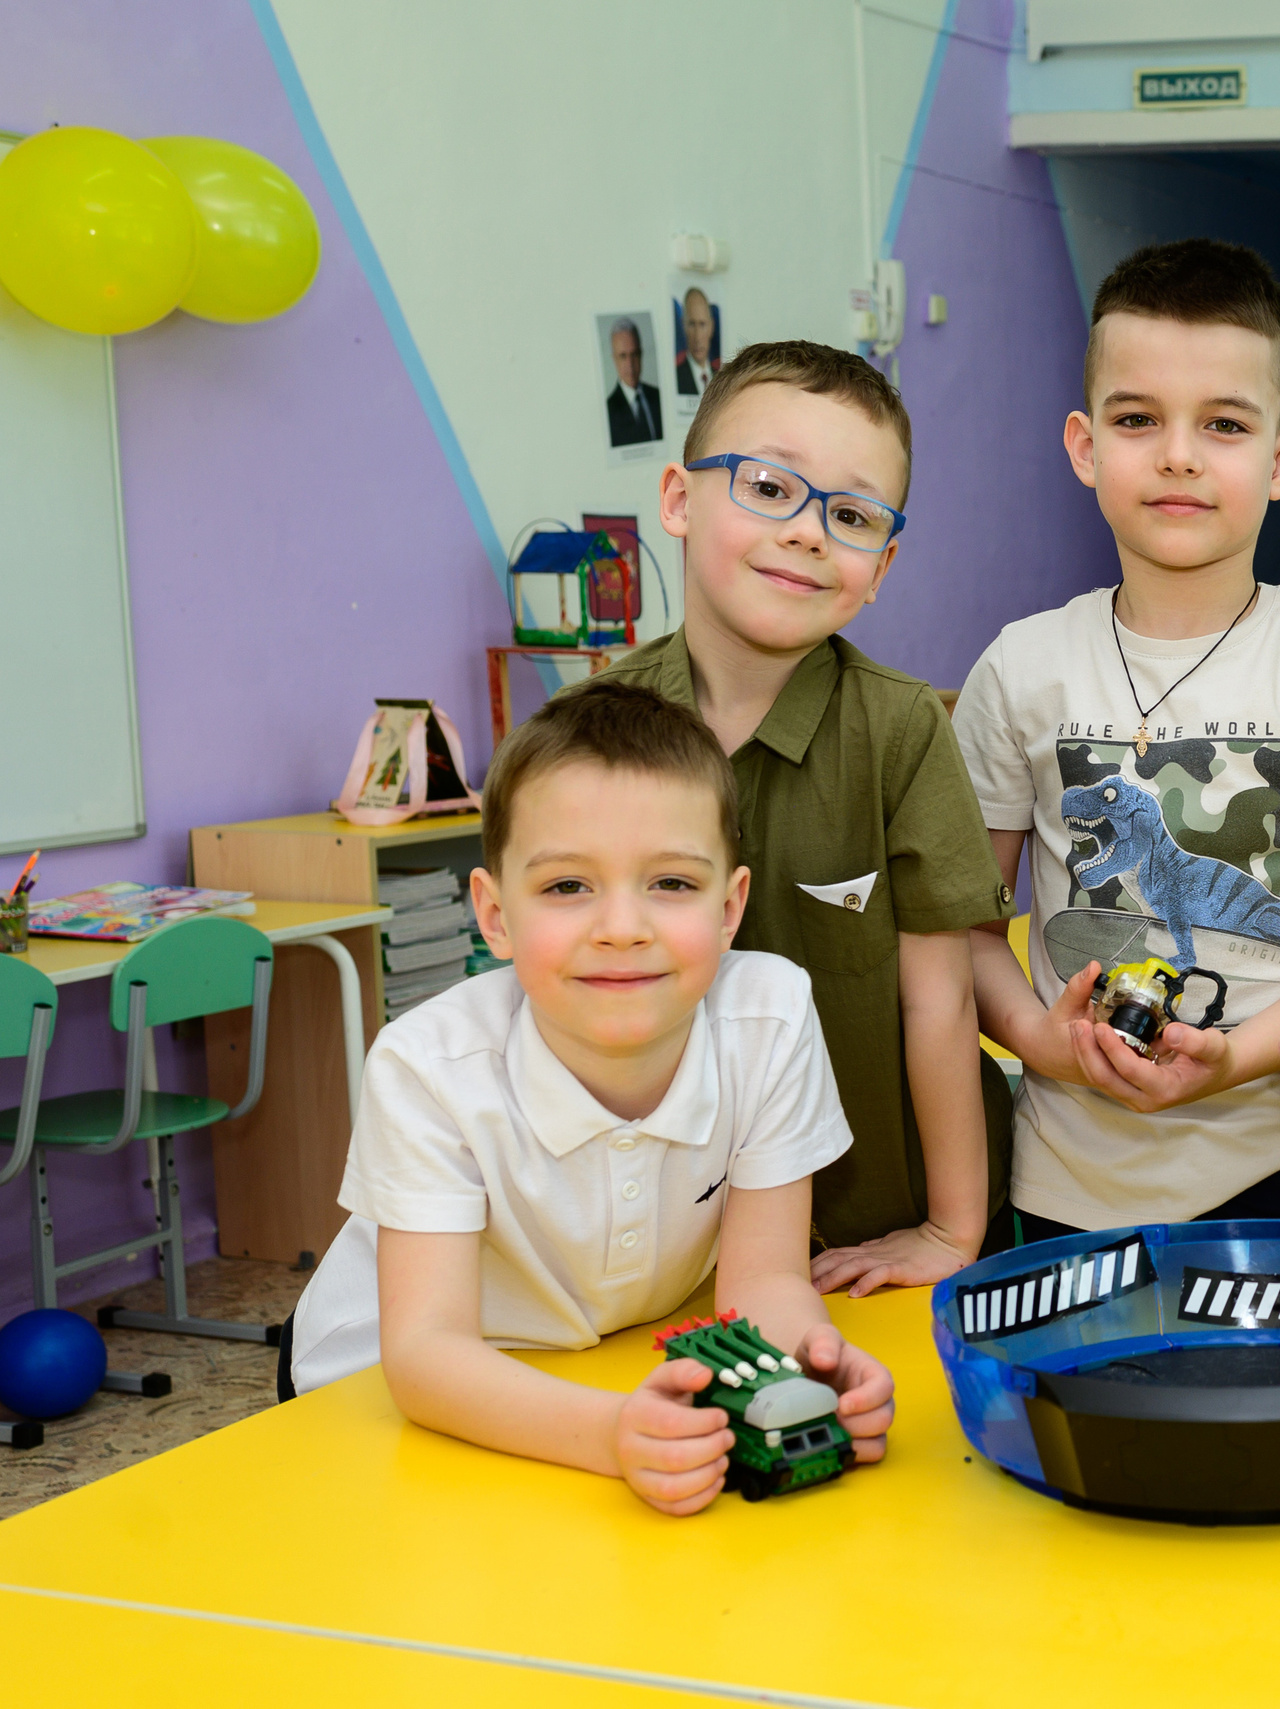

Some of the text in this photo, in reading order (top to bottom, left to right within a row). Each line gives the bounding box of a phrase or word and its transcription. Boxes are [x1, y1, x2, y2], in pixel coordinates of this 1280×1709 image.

[1143, 77, 1237, 98] ВЫХОД
[1058, 722, 1113, 738] RULE
[1138, 726, 1183, 740] HE
